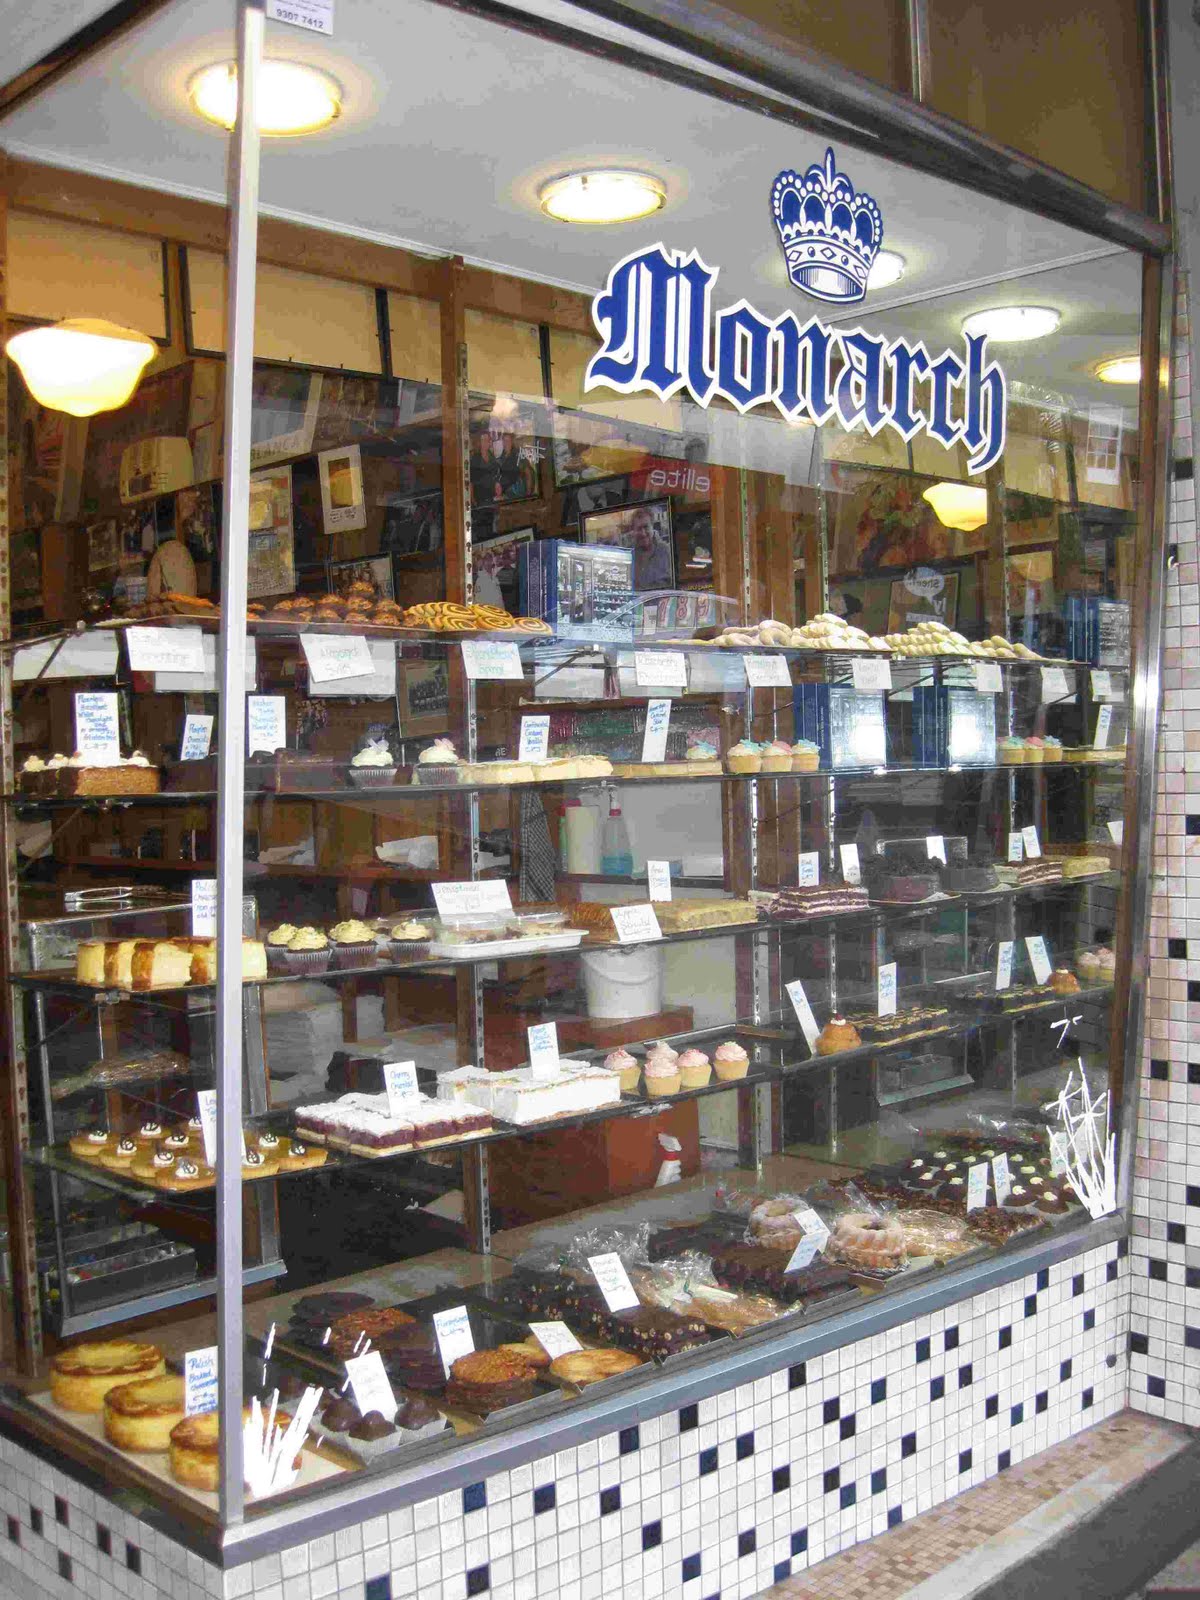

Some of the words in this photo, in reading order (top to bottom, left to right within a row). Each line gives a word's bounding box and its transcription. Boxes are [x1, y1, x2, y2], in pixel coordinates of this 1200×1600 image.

[276, 8, 299, 21] 9307
[302, 15, 324, 29] 7412
[584, 241, 1007, 476] Monarch
[187, 1354, 214, 1372] Polish
